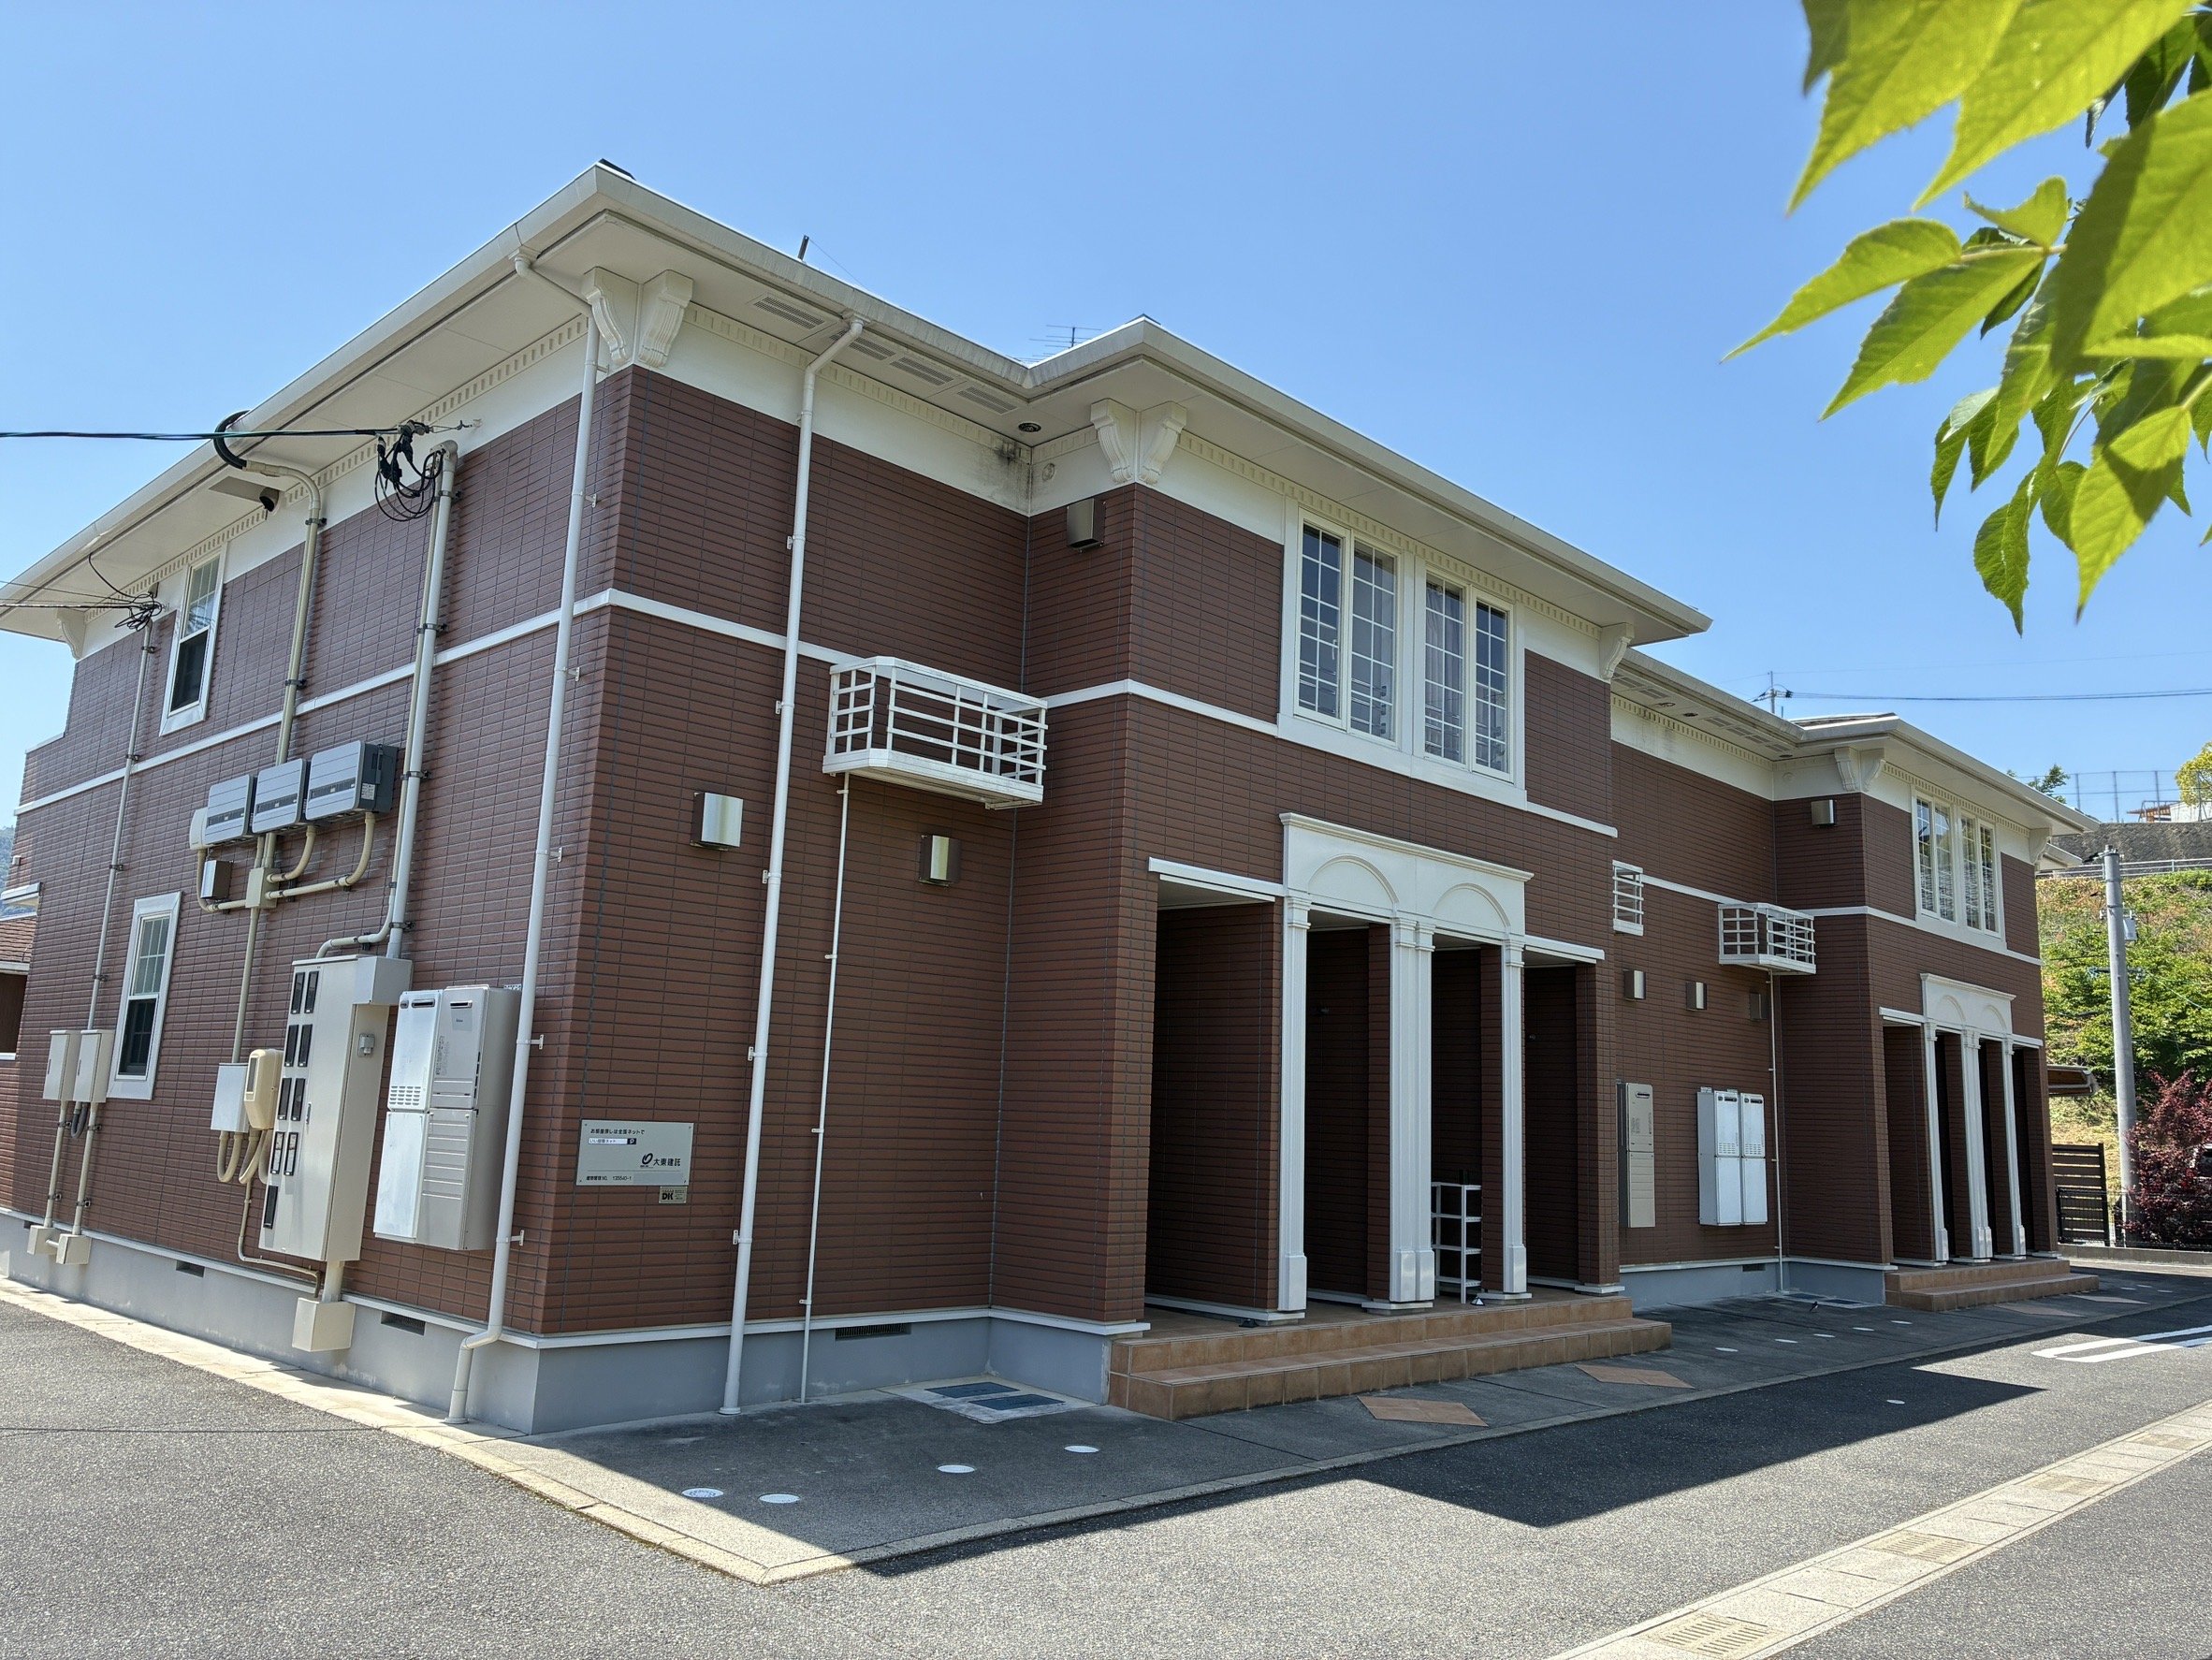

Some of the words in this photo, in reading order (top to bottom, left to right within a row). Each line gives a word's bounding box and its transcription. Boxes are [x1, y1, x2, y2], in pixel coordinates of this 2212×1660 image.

[653, 1158, 681, 1166] 大東建託
[662, 1192, 674, 1201] DK
